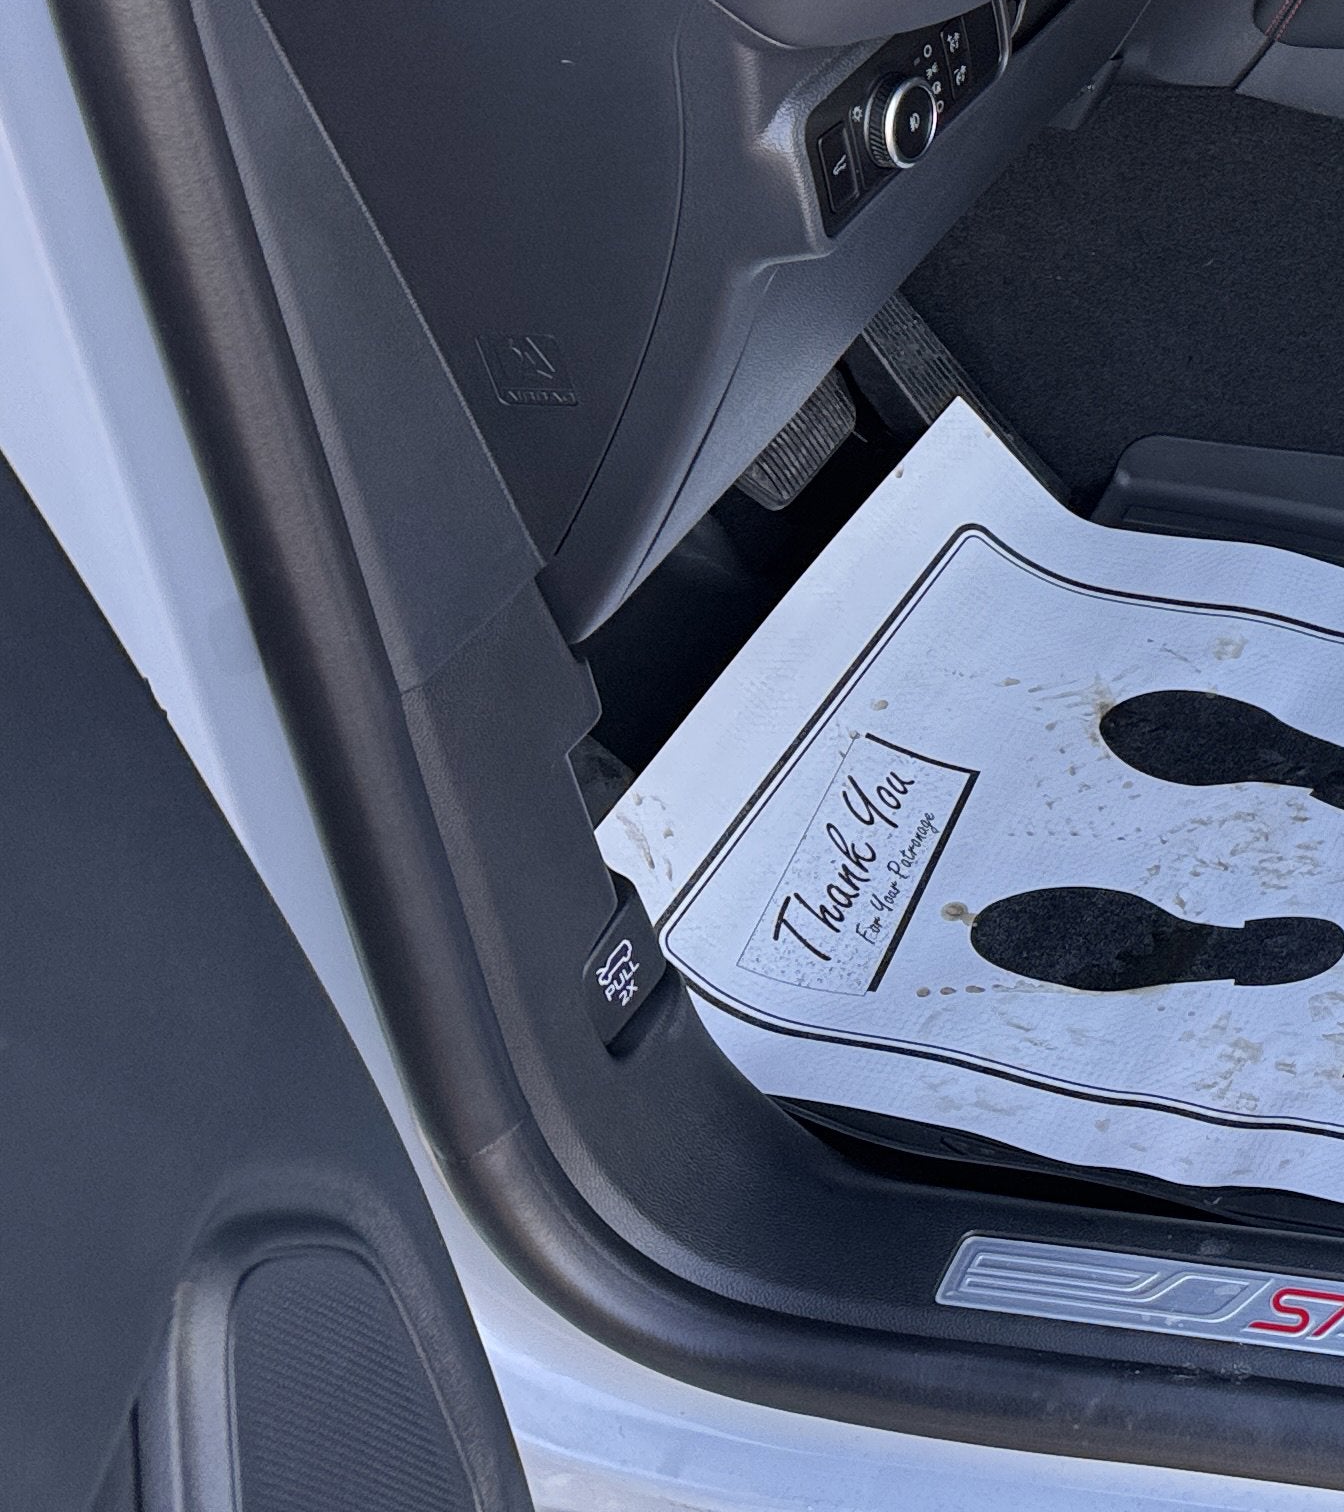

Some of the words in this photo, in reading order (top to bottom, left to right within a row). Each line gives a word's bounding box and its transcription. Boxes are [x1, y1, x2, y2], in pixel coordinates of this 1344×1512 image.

[772, 822, 877, 962] Thank
[842, 771, 915, 828] You
[856, 915, 880, 945] For
[870, 880, 900, 912] Your
[887, 811, 940, 880] Patronage
[604, 960, 640, 1002] PULL
[618, 978, 639, 1007] 2X
